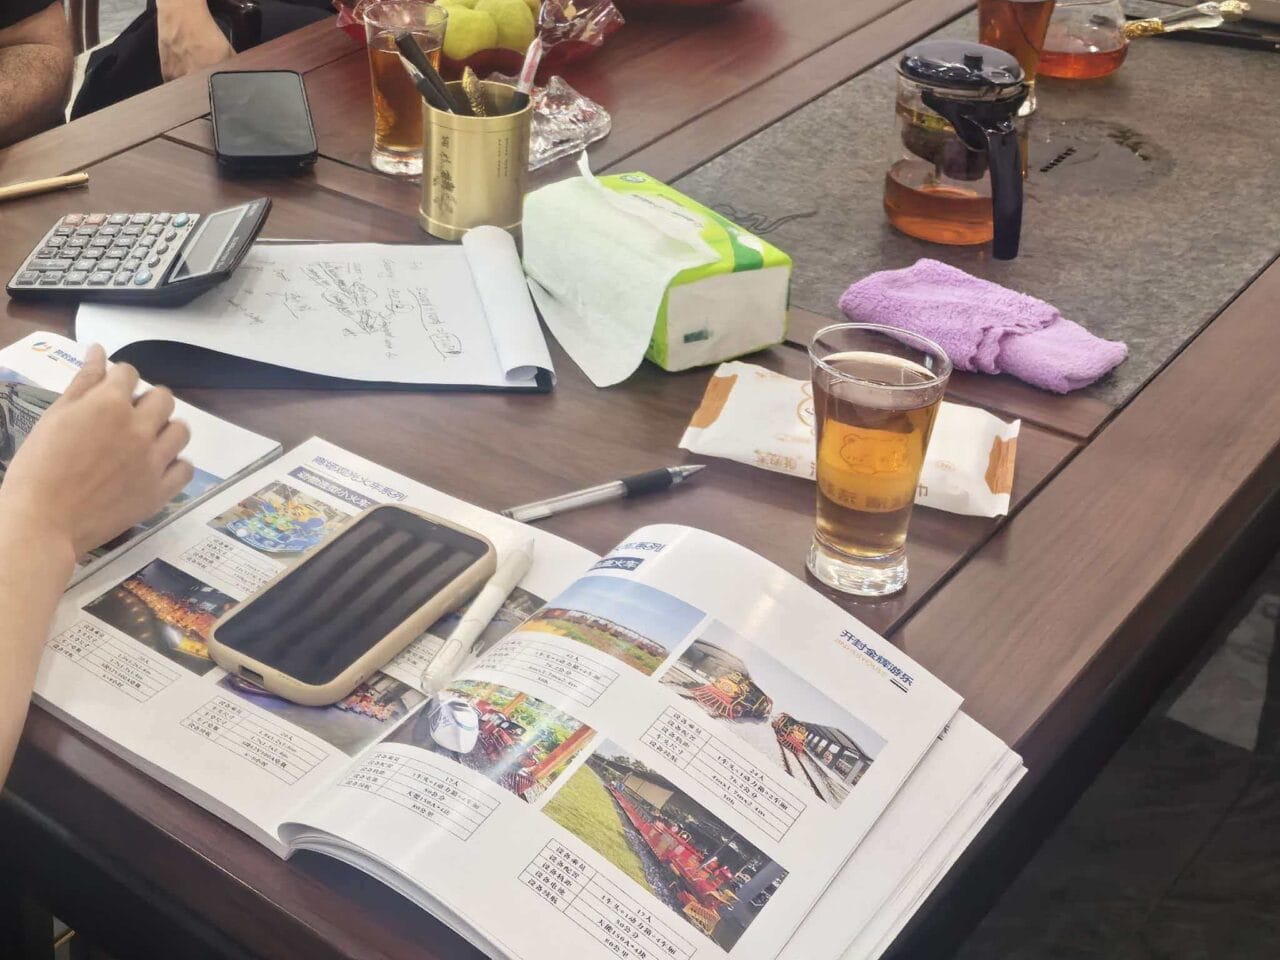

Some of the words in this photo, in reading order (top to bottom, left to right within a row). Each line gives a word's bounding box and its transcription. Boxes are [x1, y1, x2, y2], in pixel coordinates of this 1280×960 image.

[840, 629, 915, 687] 开封金辉游乐
[636, 908, 653, 923] 17人
